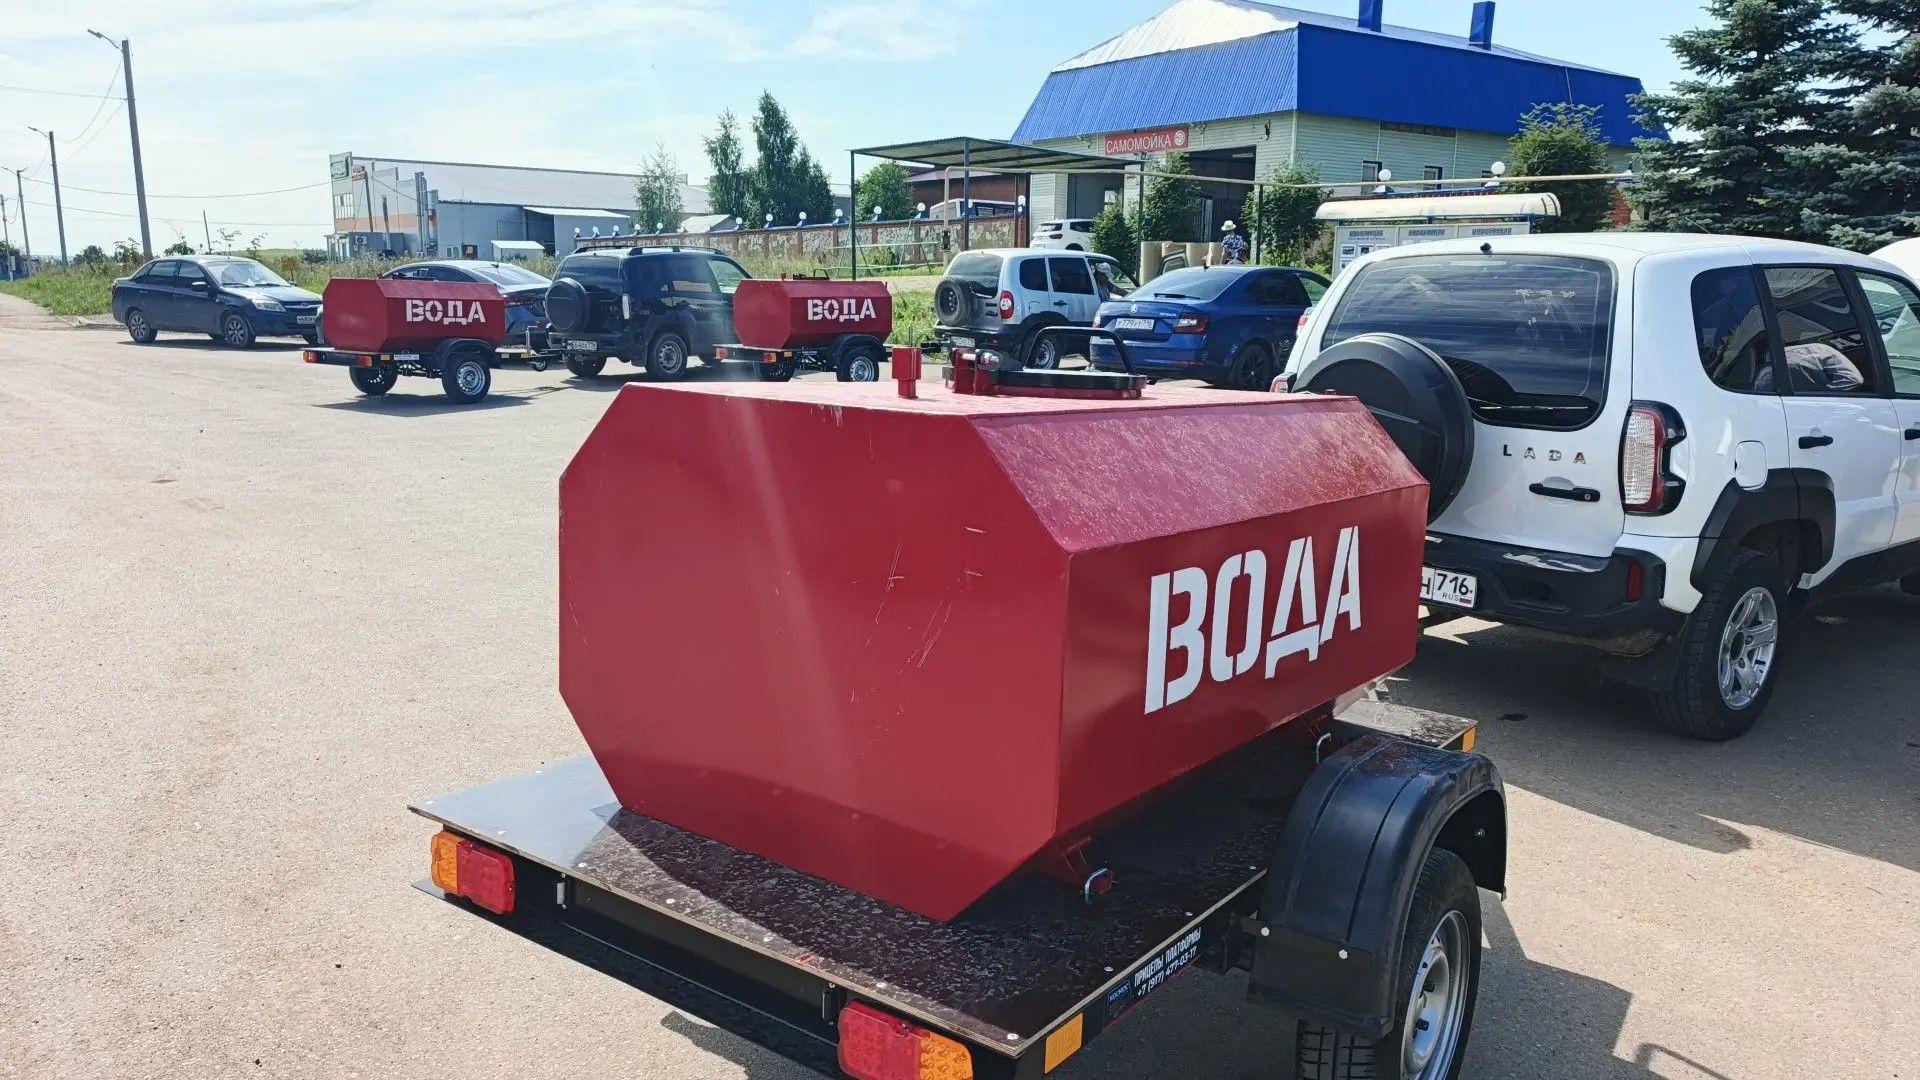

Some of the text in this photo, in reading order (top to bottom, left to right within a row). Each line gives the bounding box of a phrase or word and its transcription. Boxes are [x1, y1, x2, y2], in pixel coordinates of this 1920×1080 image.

[1106, 134, 1171, 153] САМОМОЙКА
[406, 299, 486, 325] ВОДА
[807, 299, 877, 322] ВОДА
[1503, 444, 1586, 464] LADA
[1437, 572, 1469, 596] 716
[1442, 592, 1459, 602] RUS
[1144, 526, 1361, 714] ВОДА
[1134, 926, 1202, 987] ПРИЦЕПЫ ПЛАТФОРМЫ
